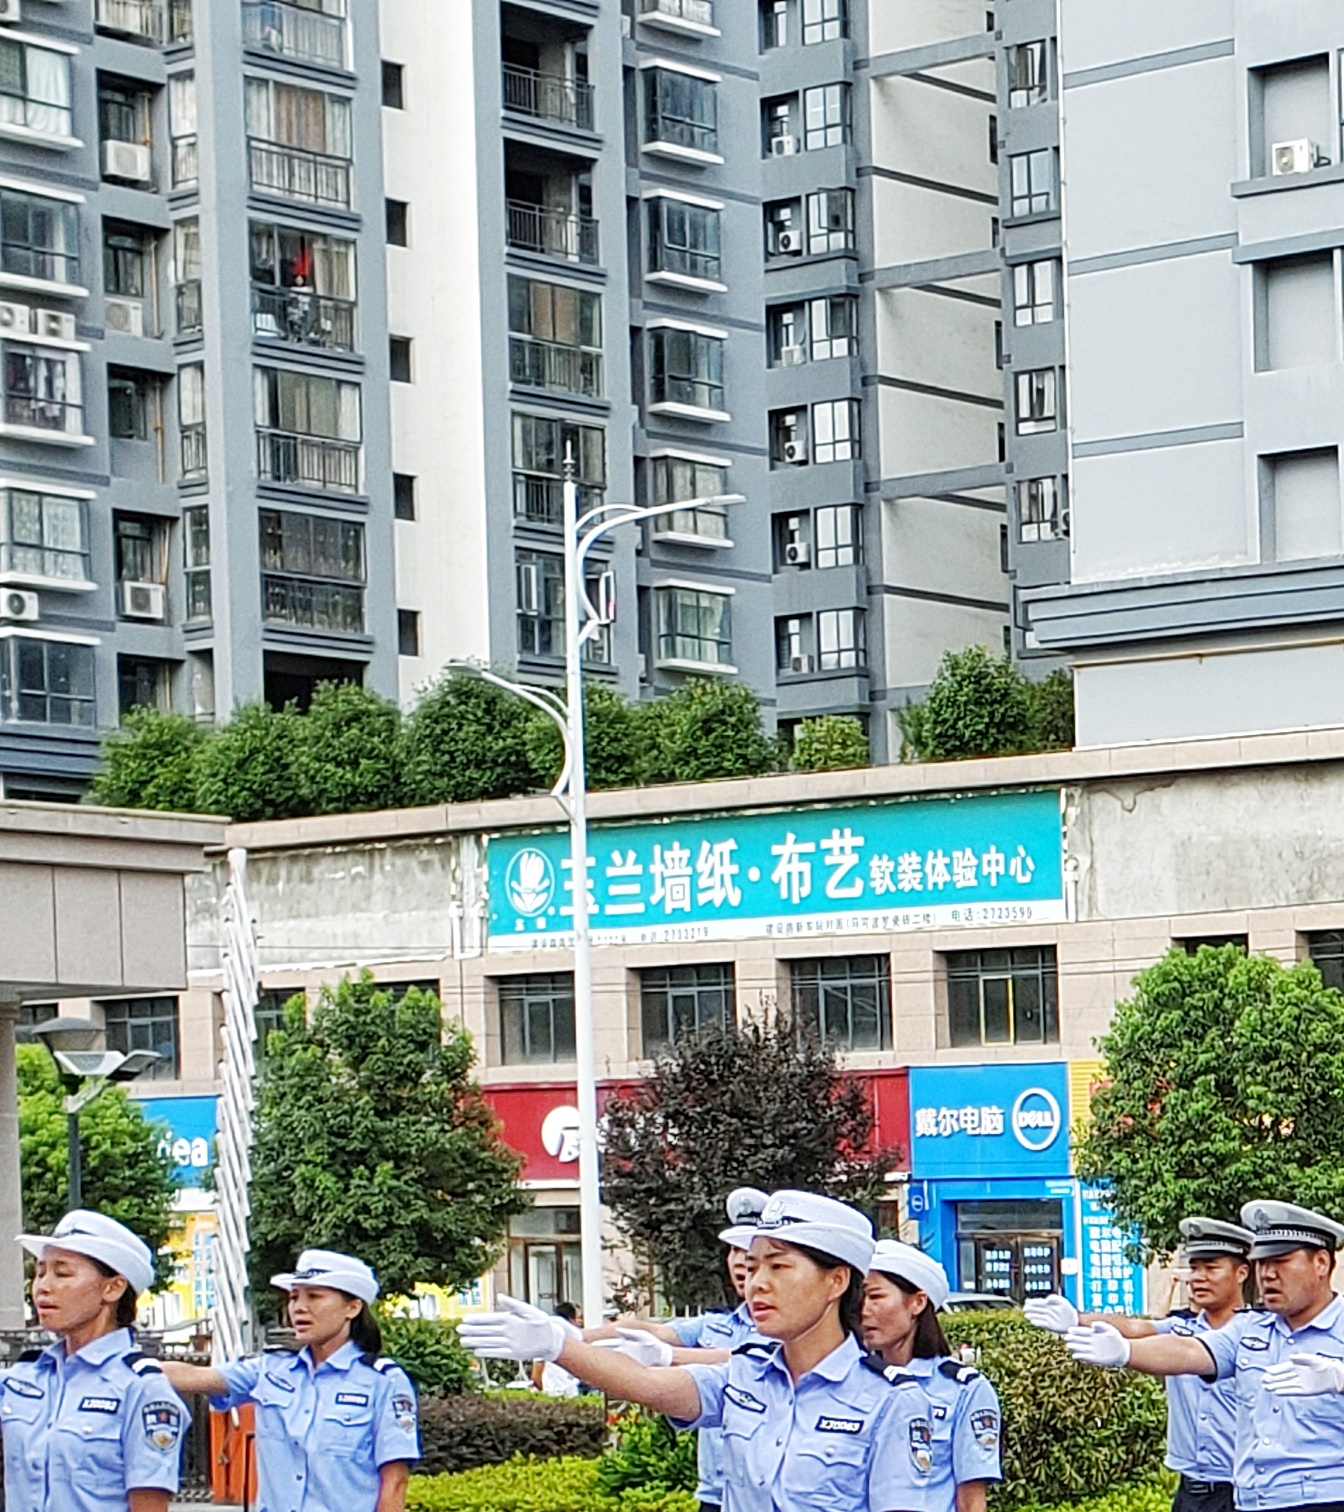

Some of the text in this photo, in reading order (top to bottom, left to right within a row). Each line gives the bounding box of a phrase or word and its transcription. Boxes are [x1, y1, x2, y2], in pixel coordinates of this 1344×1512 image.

[868, 844, 1036, 896] 软装体验中心
[915, 1105, 1054, 1138] 戴尔电脑 DELL
